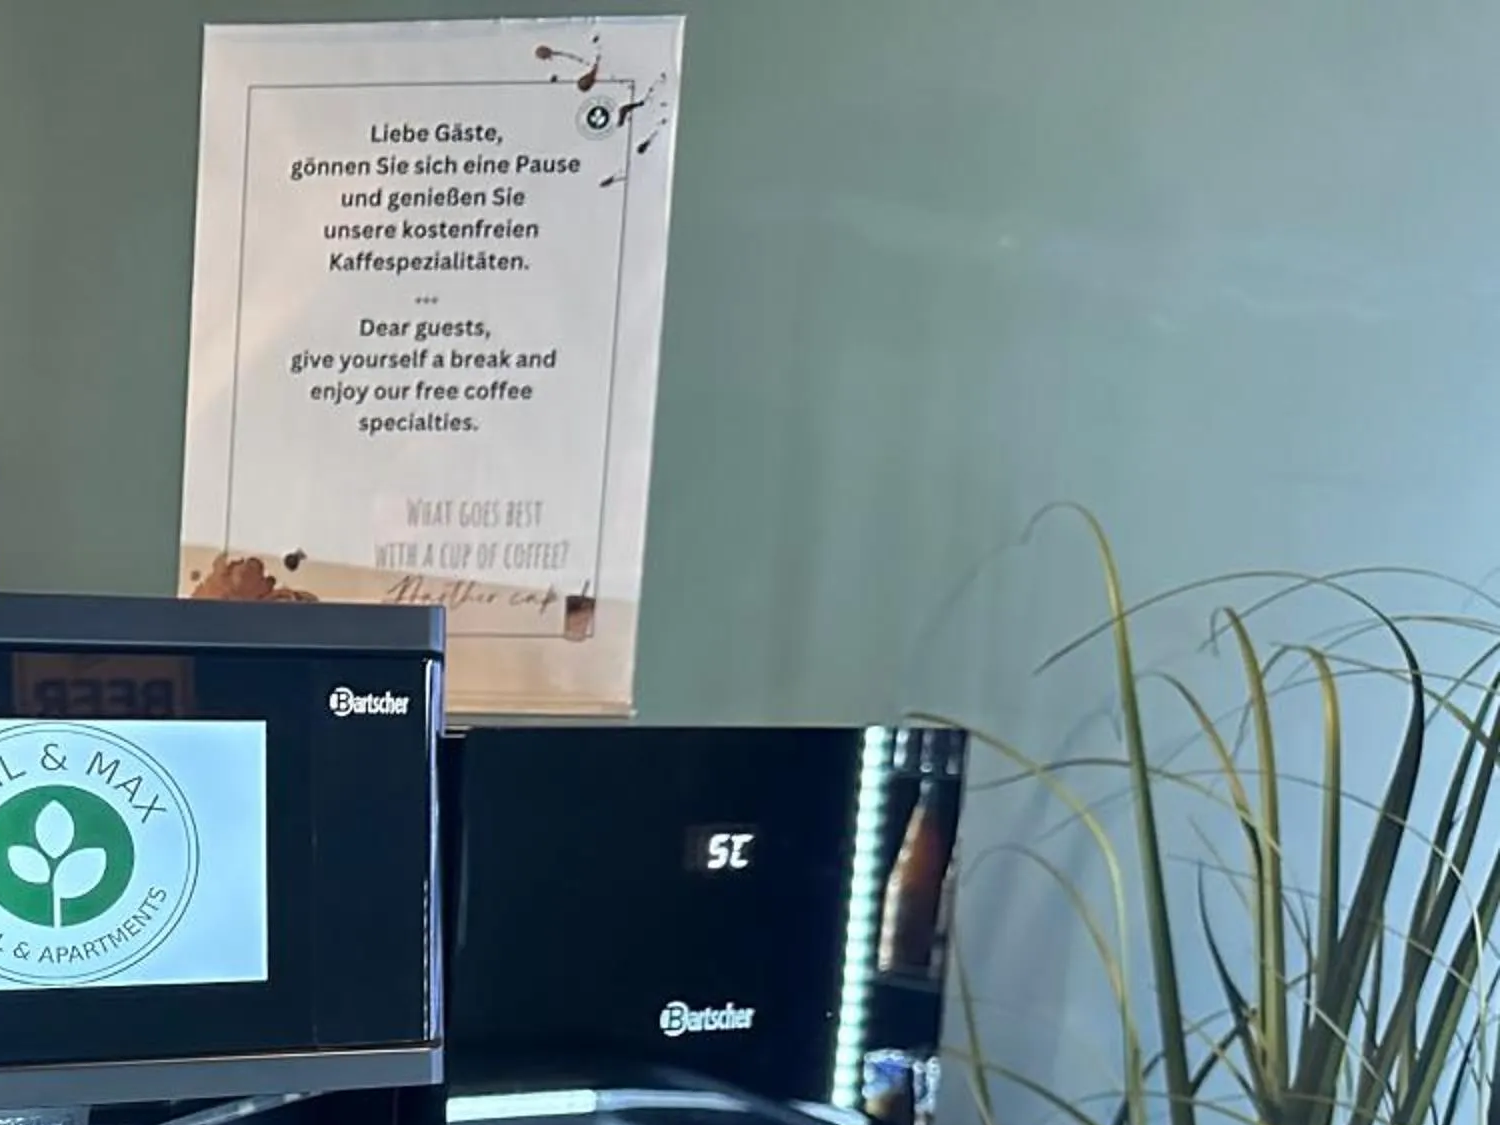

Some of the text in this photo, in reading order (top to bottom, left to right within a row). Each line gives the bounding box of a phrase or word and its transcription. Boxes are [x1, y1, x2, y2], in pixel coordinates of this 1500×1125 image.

[370, 124, 503, 144] Liebe Gäste,
[291, 155, 581, 179] gönnen Sie sich eine Pause
[341, 187, 525, 212] und genießen Sie
[323, 219, 539, 240] unsere kostenfreien
[329, 252, 530, 275] Kaffespezialitäten.
[359, 319, 492, 342] Dear guests,
[291, 349, 557, 375] give yourself a break and
[310, 381, 533, 406] enjoy our free coffee
[358, 413, 480, 435] specialties.
[406, 498, 544, 528] WHAT GOES BEST
[422, 543, 434, 567] A
[440, 544, 473, 568] CUP
[329, 686, 410, 717] Bartscher
[40, 742, 67, 772] &
[85, 750, 167, 824] MAX
[12, 941, 30, 961] &
[36, 885, 167, 965] APARTMENTS
[660, 1001, 755, 1037] Bartscher
